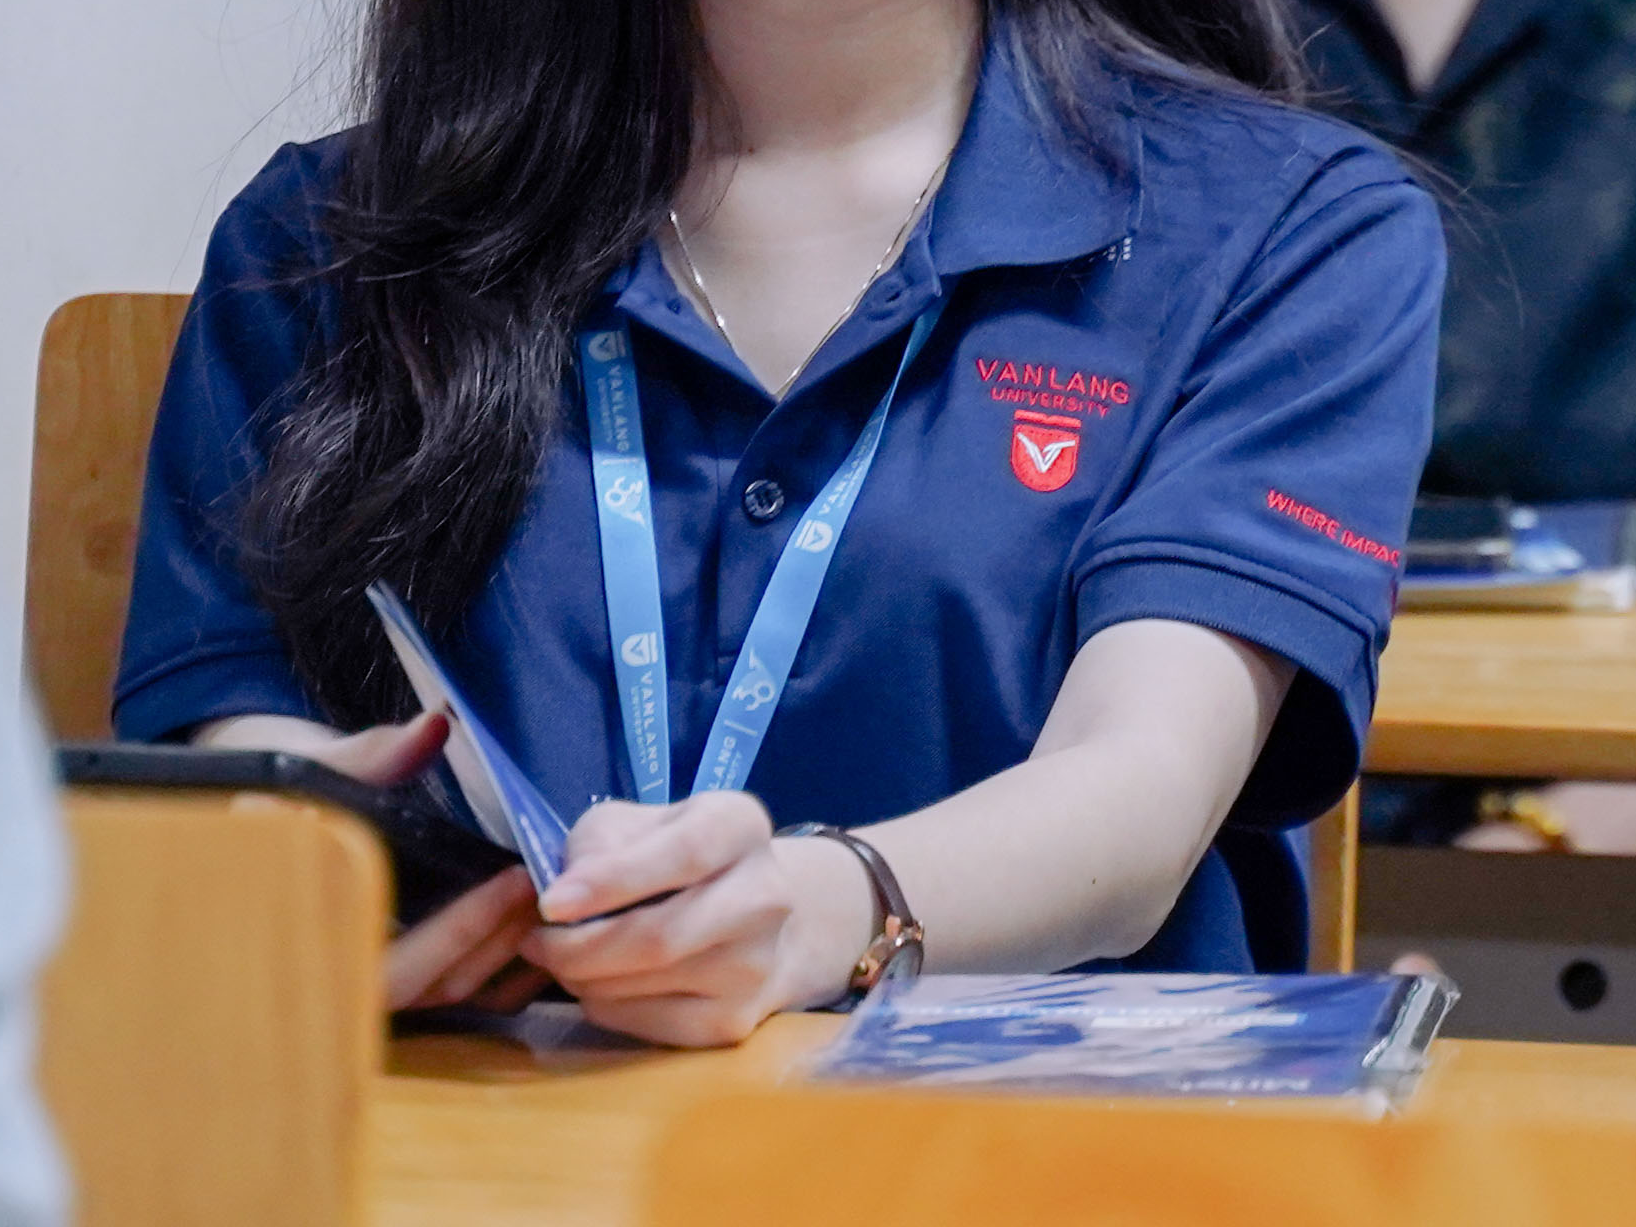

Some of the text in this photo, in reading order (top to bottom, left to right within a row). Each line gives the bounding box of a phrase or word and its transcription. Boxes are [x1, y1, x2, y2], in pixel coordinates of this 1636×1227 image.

[991, 387, 1110, 418] UNIVERSITY
[1267, 489, 1401, 568] WHERE IMPAC
